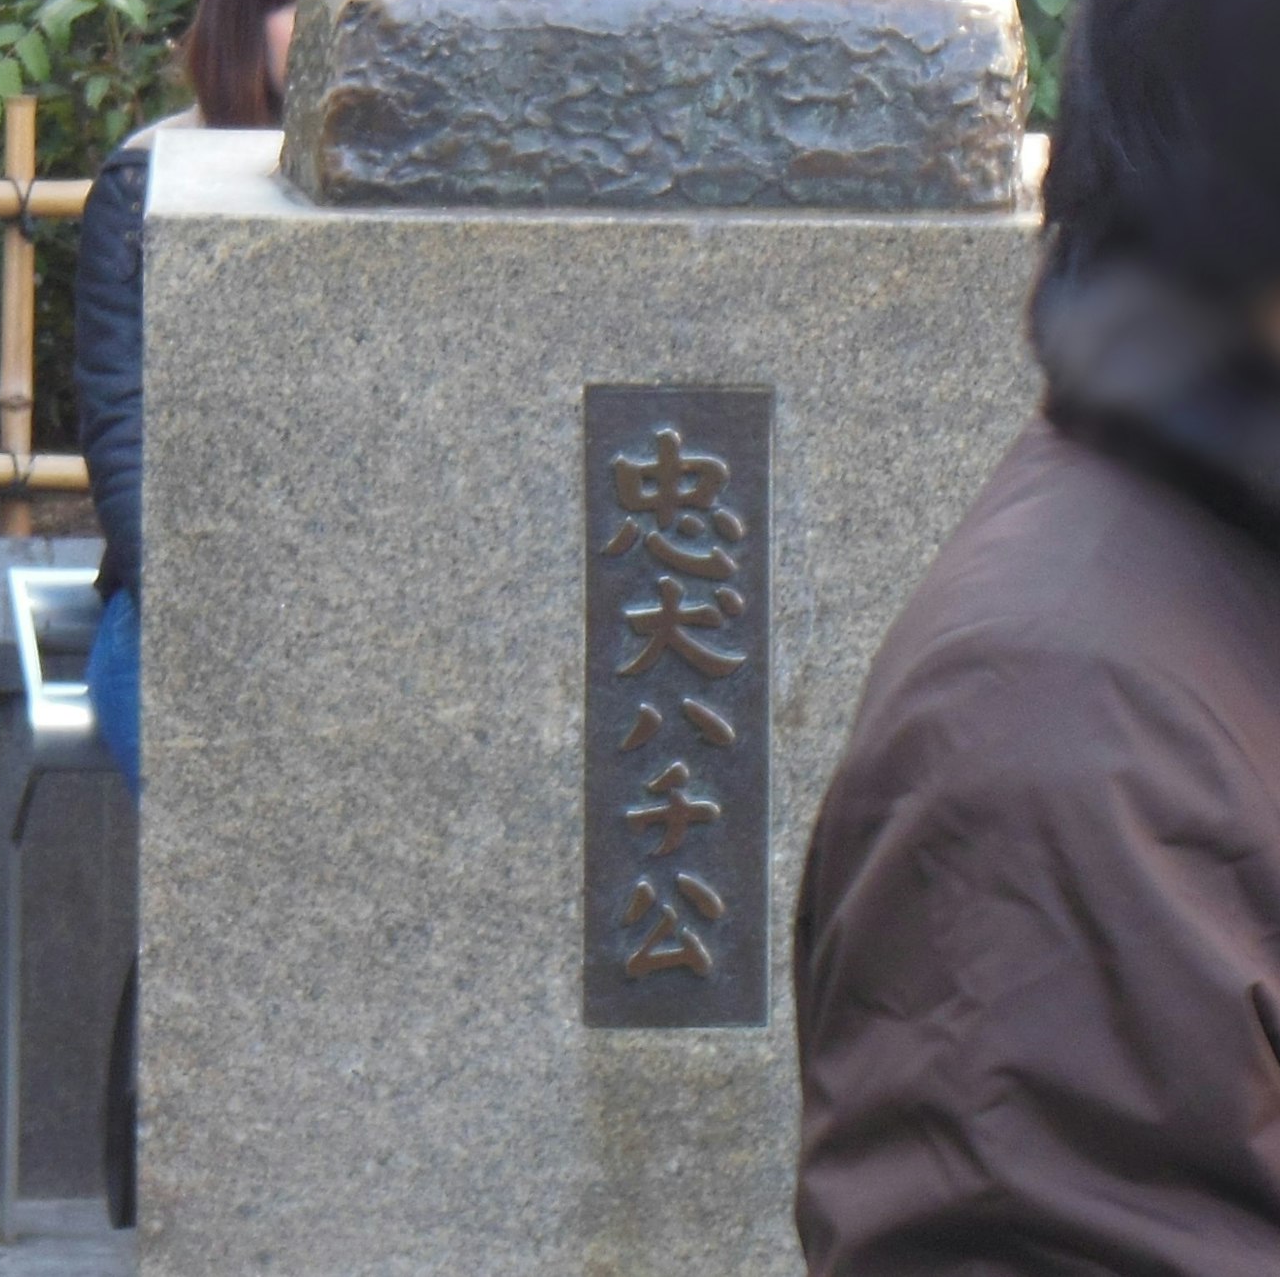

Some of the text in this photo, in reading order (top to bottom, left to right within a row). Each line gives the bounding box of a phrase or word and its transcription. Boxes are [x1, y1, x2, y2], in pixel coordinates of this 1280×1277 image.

[603, 428, 748, 977] 忠犬ハチ公
